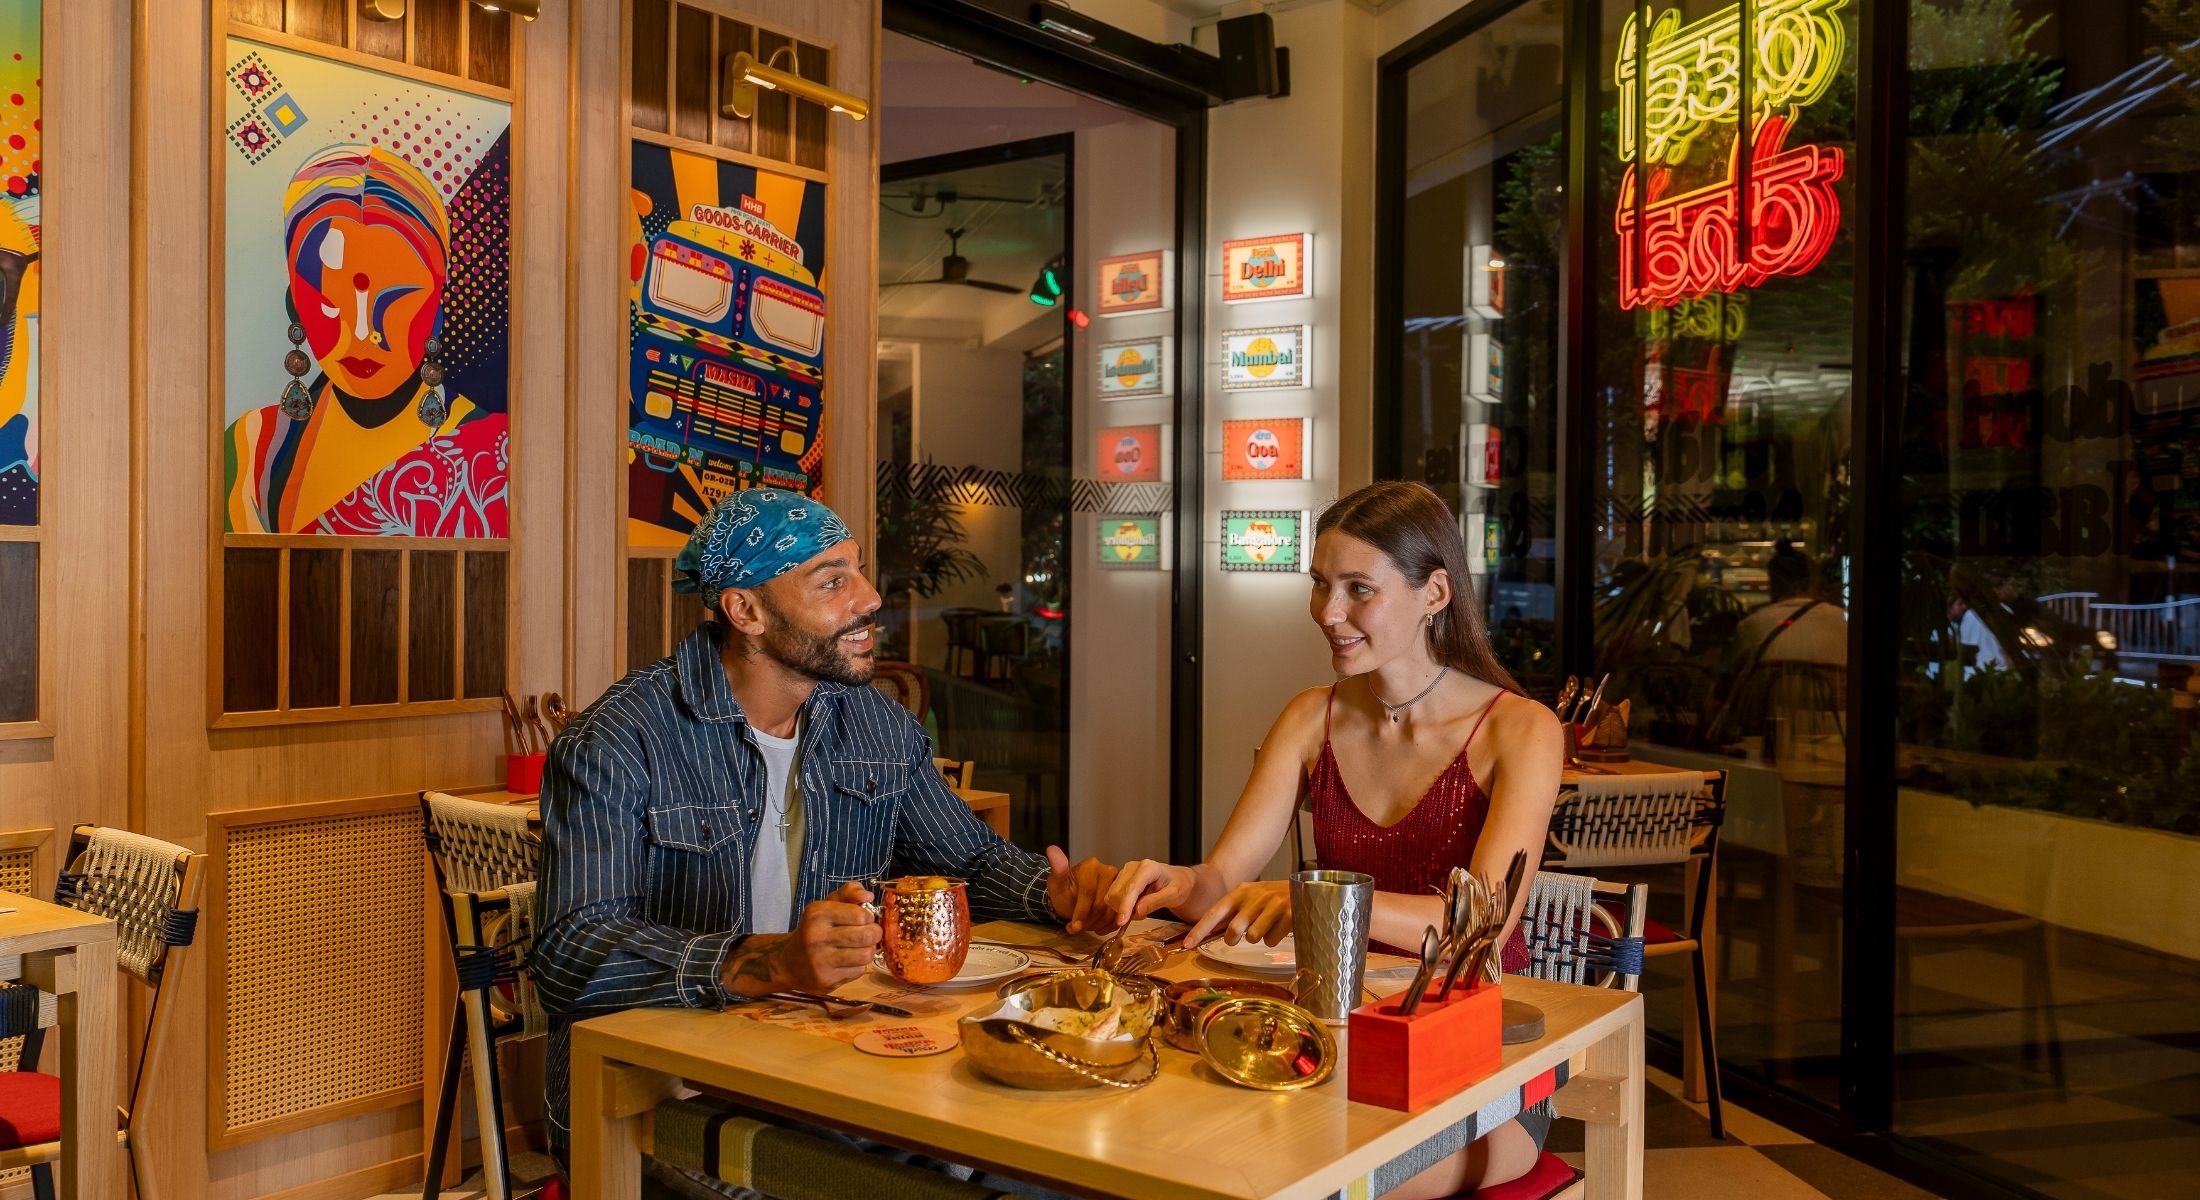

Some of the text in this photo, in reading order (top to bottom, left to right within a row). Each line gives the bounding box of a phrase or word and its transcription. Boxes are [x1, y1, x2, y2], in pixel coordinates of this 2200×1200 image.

[744, 199, 762, 214] HHB
[694, 206, 800, 260] GOODS-CARRIER
[1240, 259, 1286, 280] Delhi
[1231, 347, 1293, 368] Mumbai
[705, 364, 757, 393] MASKA
[629, 429, 703, 467] ROAD N
[1247, 442, 1279, 459] Goa
[708, 458, 734, 472] welcome
[763, 466, 808, 490] KING
